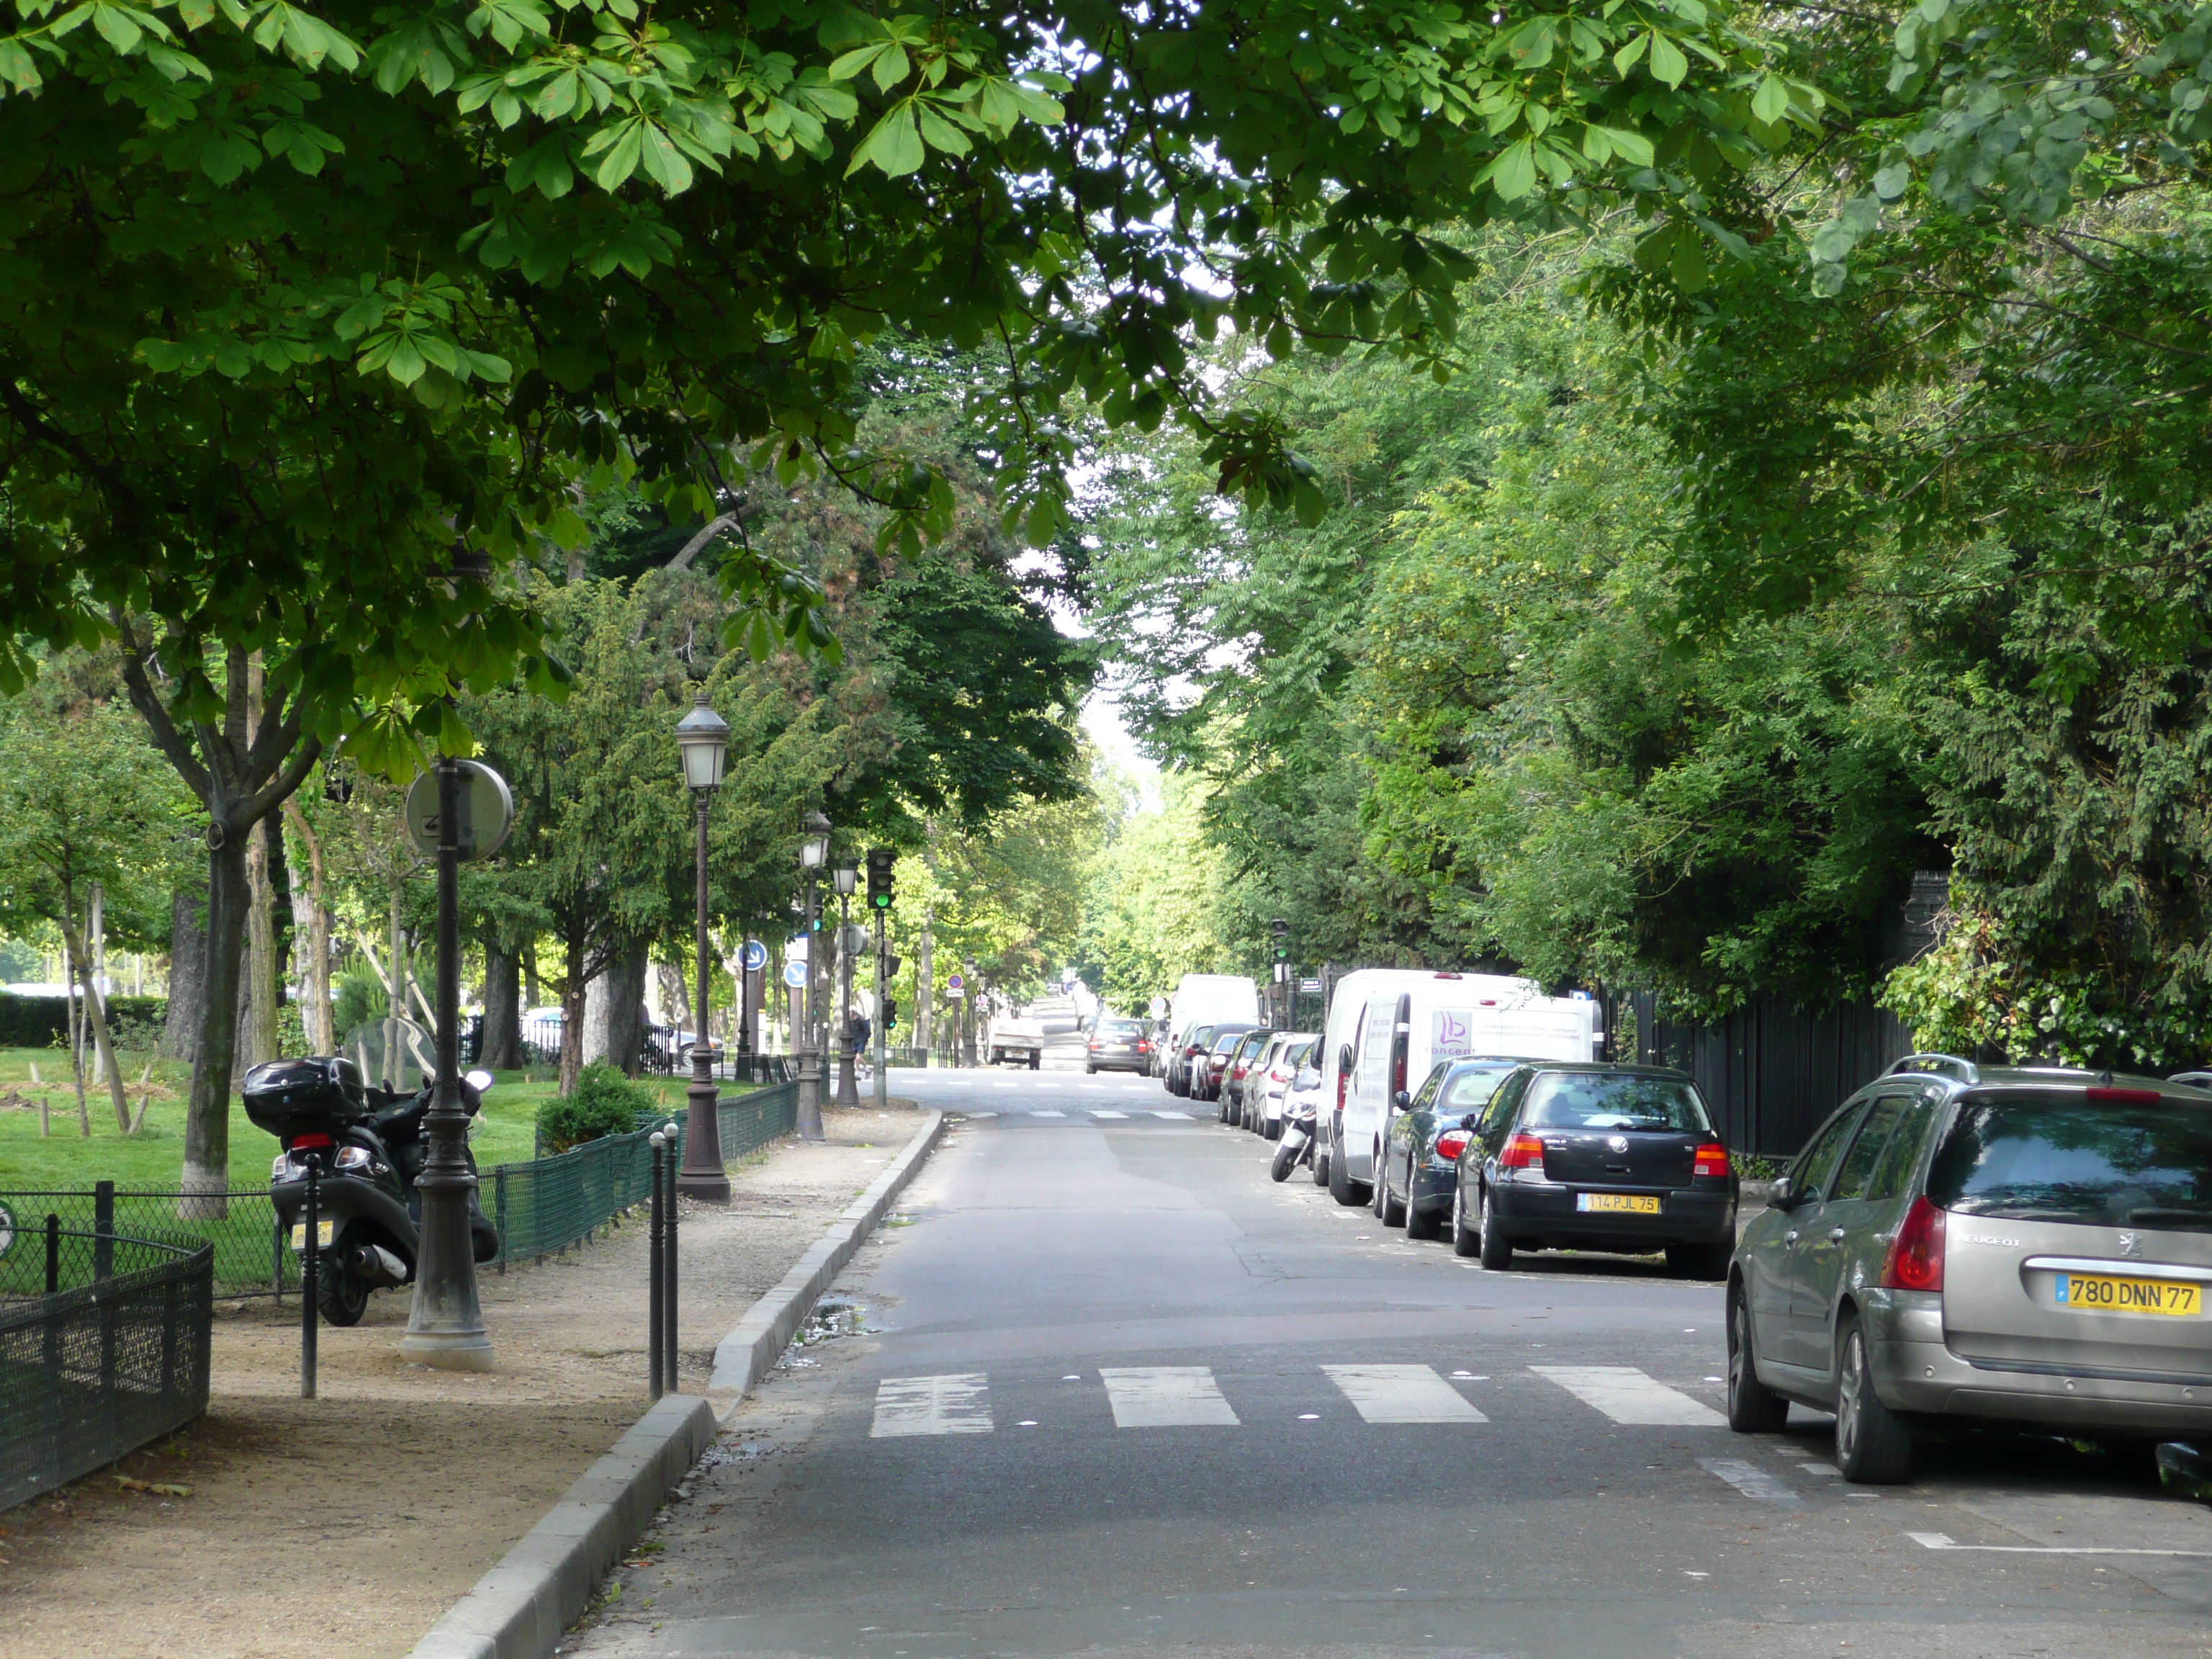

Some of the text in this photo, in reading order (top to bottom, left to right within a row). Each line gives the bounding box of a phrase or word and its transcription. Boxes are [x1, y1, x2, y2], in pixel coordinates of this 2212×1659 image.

[1589, 1197, 1654, 1210] 114 PJL 75
[1956, 1234, 2021, 1248] PEUGEOT
[2070, 1279, 2114, 1303] 780
[2119, 1282, 2162, 1308] DNN
[2167, 1287, 2195, 1310] 77
